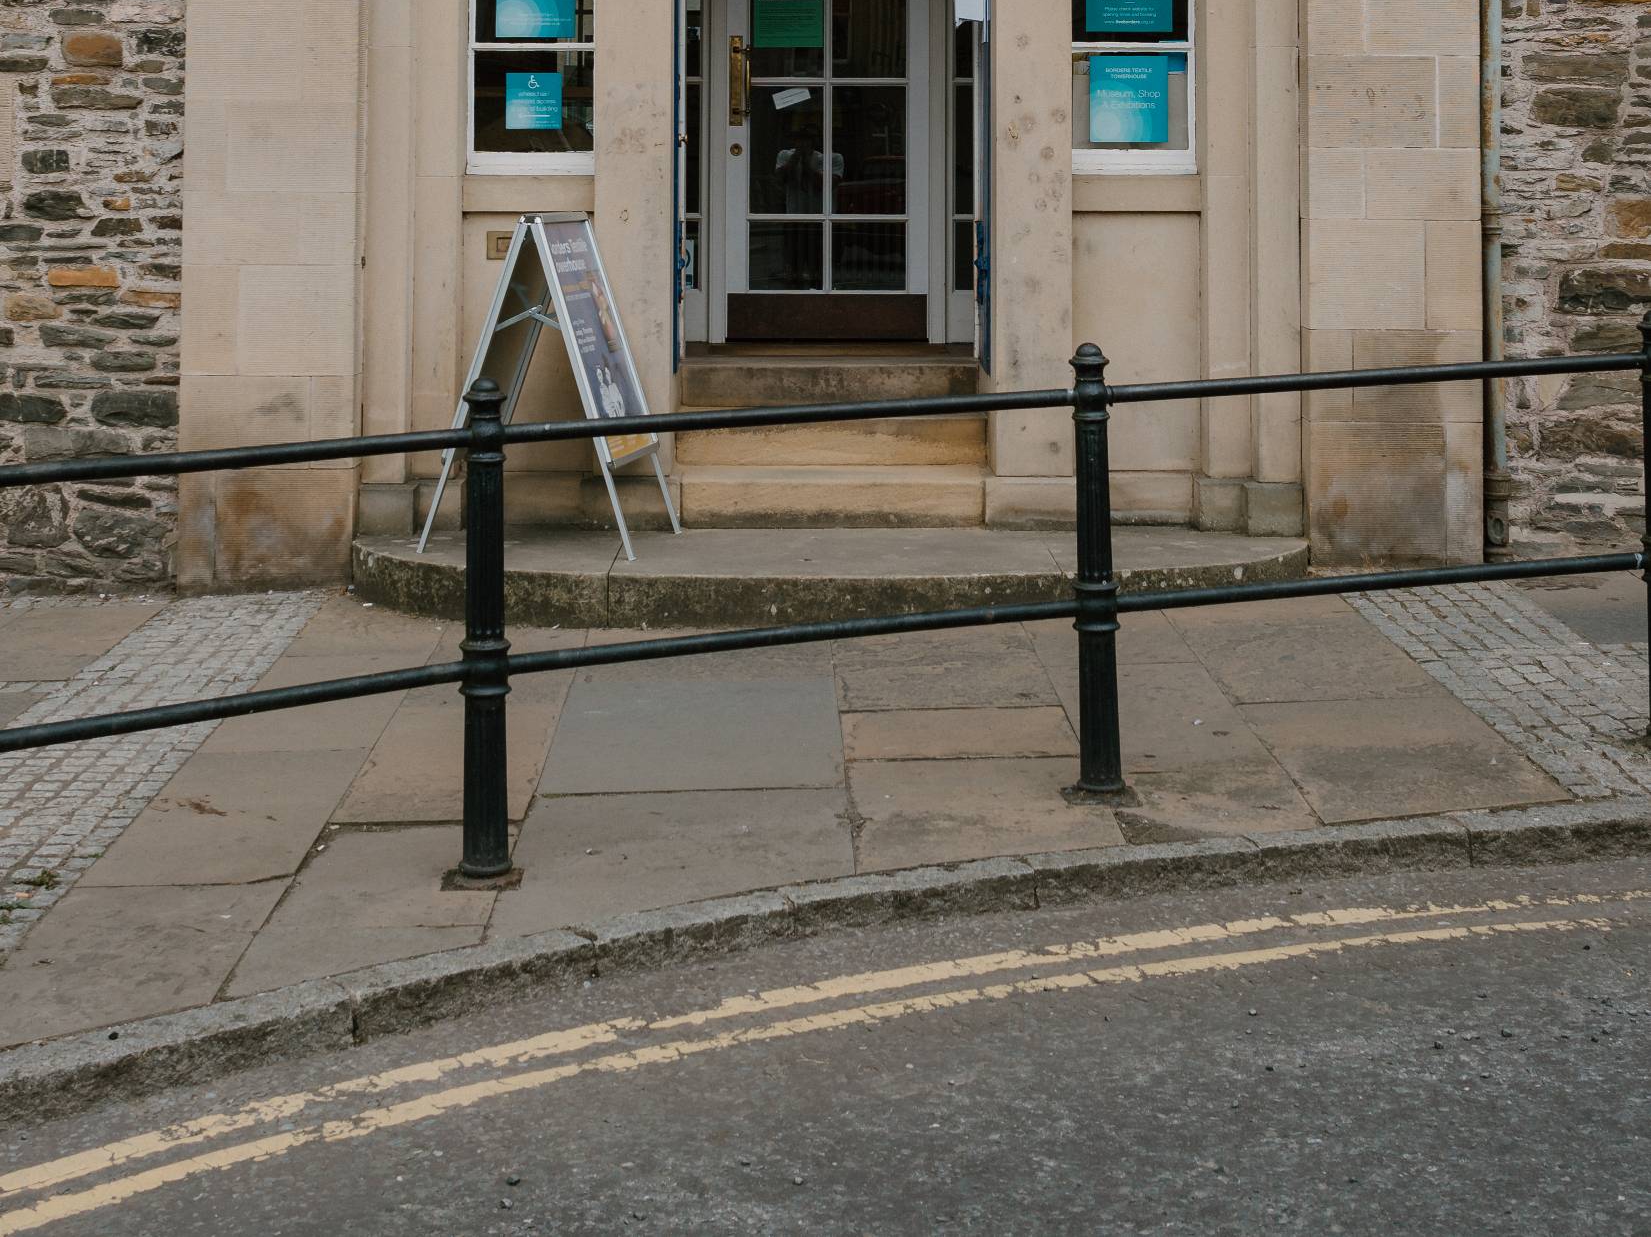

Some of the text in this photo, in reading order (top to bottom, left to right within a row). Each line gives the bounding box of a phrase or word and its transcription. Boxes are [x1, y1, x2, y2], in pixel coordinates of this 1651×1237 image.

[1097, 90, 1161, 98] Museum, Shop
[555, 257, 587, 273] owerhouse
